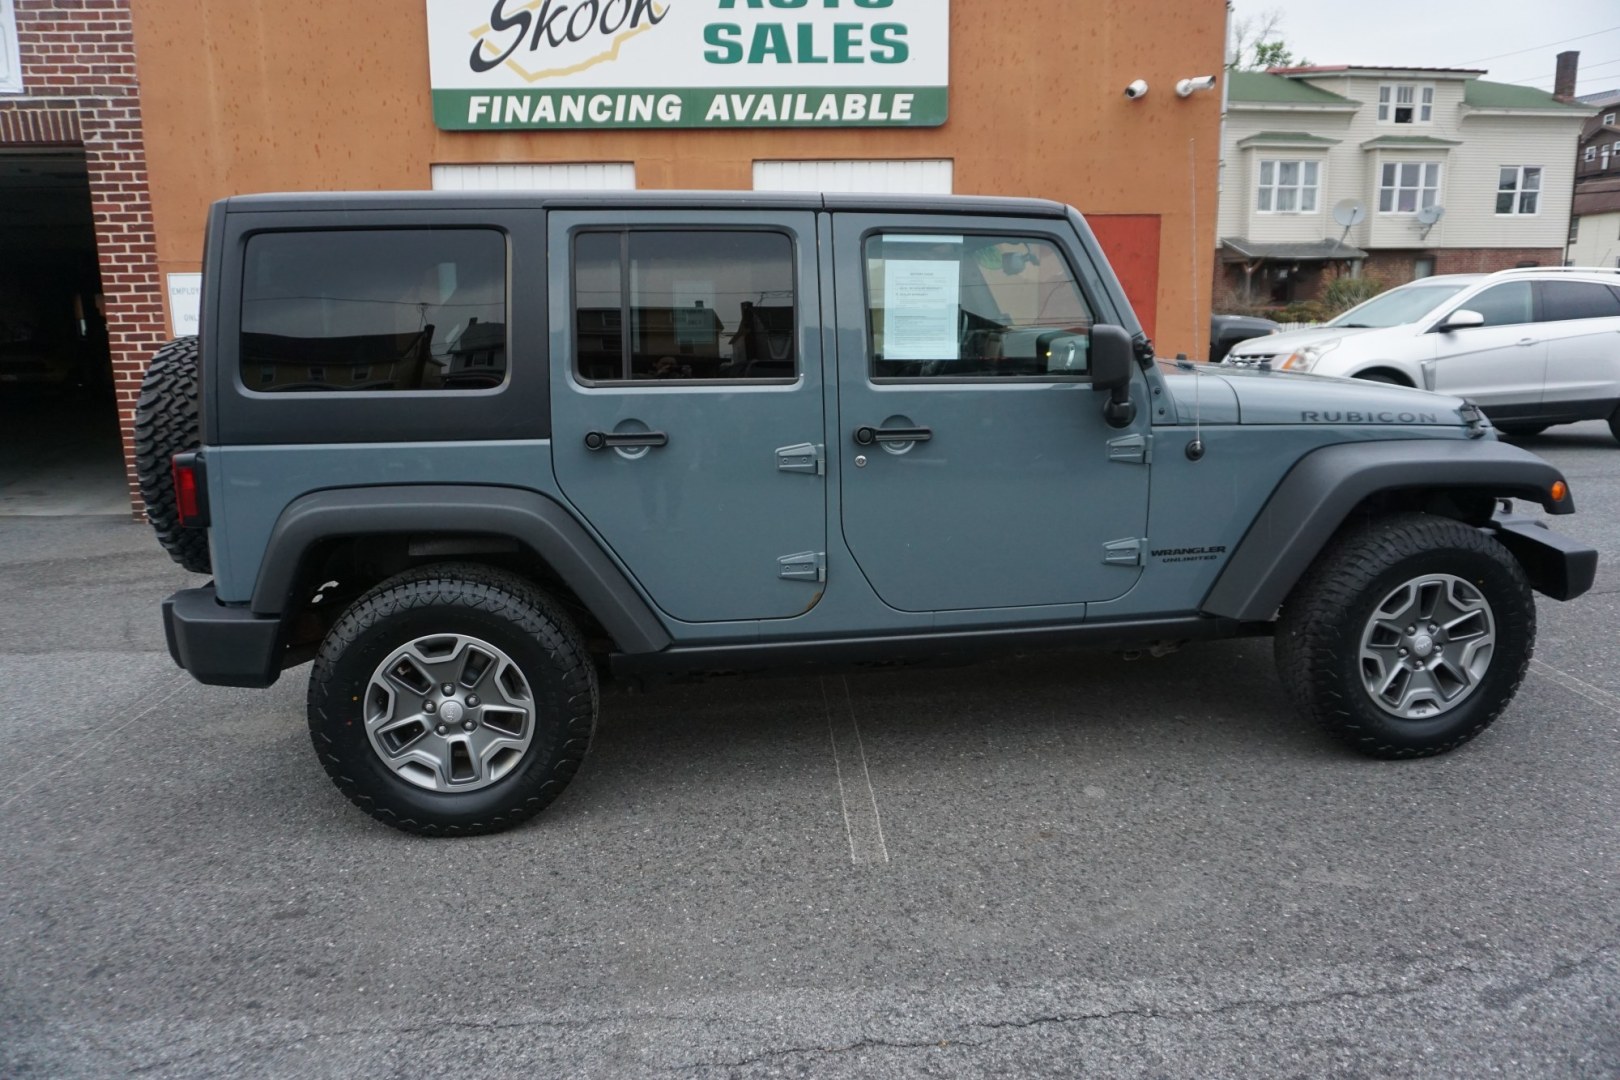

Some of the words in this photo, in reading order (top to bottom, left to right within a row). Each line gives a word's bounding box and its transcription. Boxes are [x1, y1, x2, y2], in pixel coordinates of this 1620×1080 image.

[703, 22, 909, 65] SALES
[468, 95, 683, 123] FINANCING
[705, 93, 914, 121] AVAILABLE
[1300, 410, 1438, 424] RUBICON
[1151, 545, 1226, 556] WRANGLER
[1162, 555, 1217, 563] UNLIMITED
